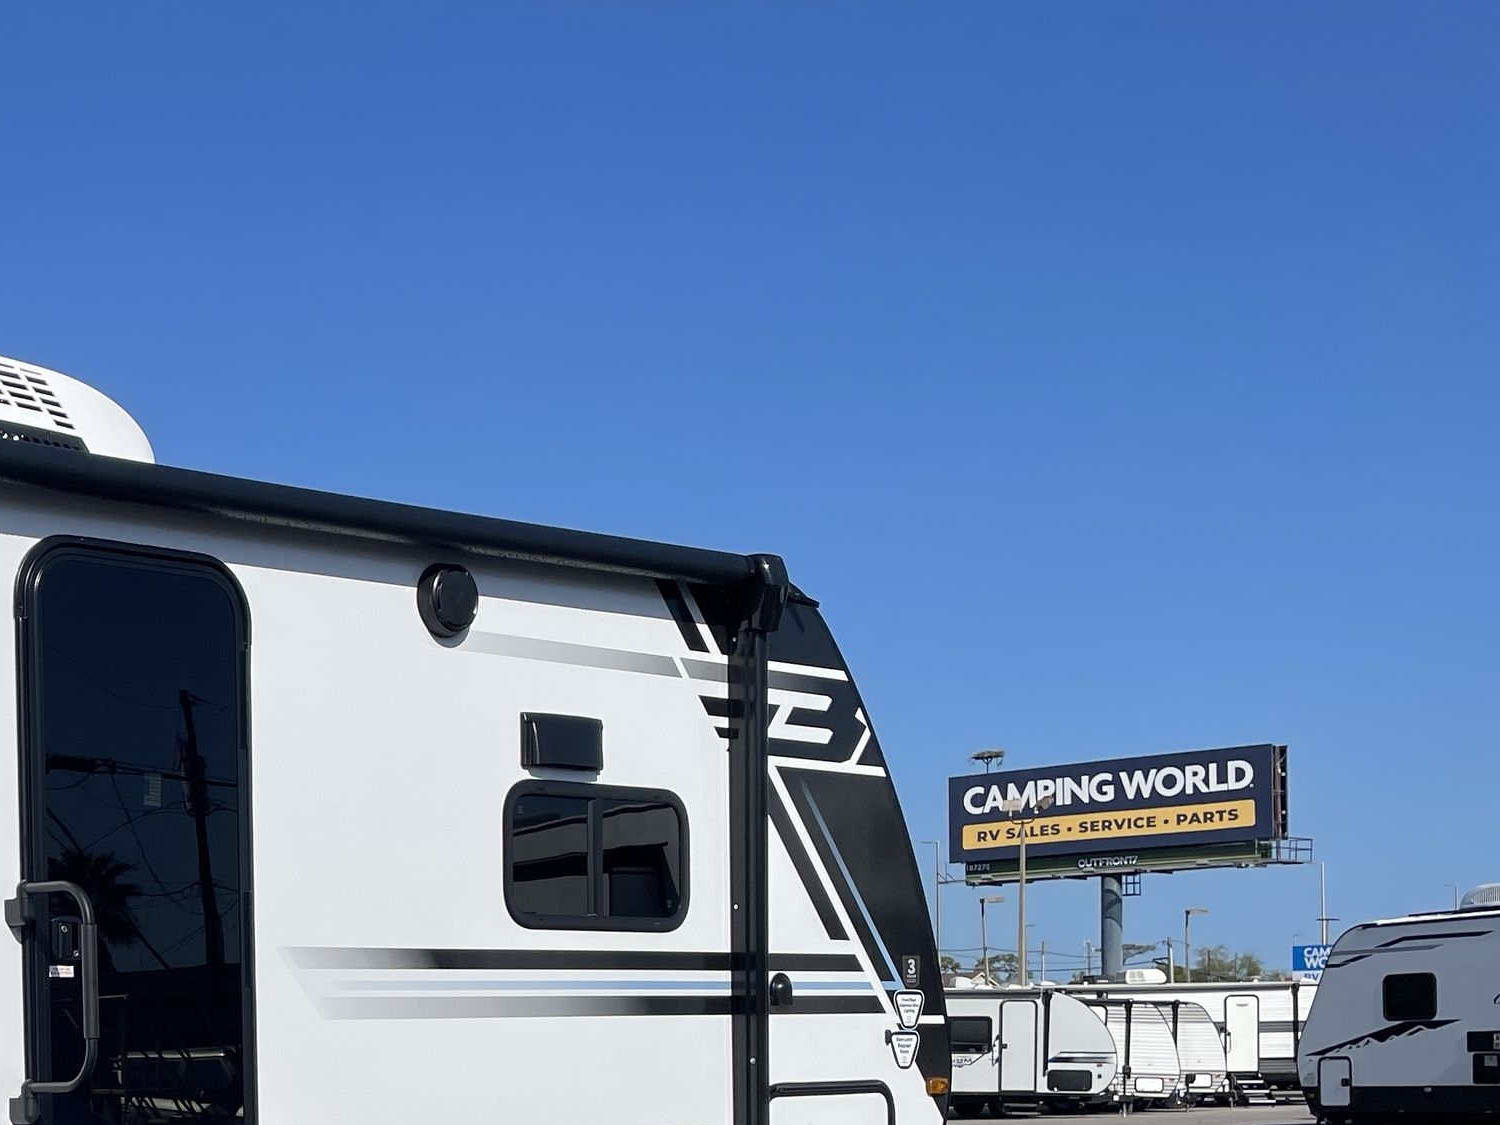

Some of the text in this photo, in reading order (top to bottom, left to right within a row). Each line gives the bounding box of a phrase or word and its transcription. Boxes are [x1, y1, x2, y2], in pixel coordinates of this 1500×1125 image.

[963, 760, 1254, 815] CAMPING WORLD
[977, 809, 1239, 842] RV SALES SERVICE PARTS
[1303, 947, 1332, 957] CAM
